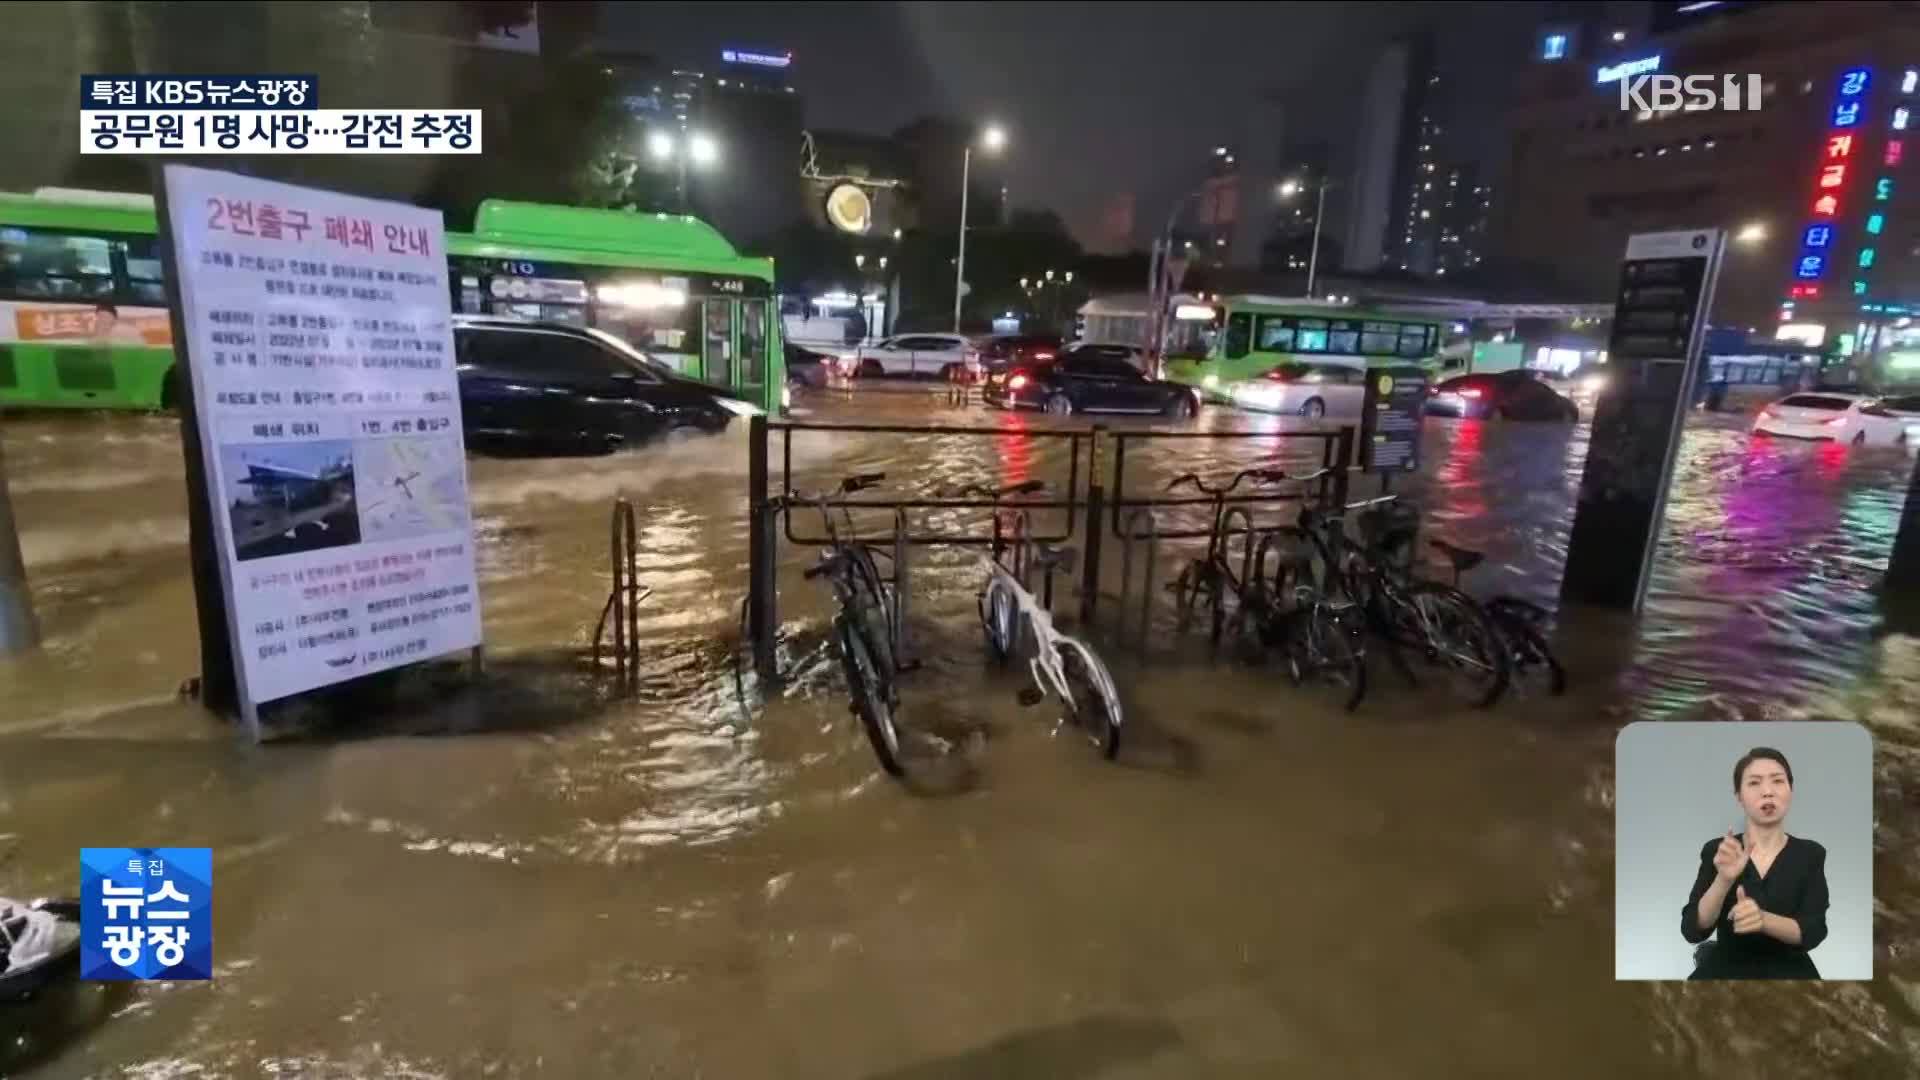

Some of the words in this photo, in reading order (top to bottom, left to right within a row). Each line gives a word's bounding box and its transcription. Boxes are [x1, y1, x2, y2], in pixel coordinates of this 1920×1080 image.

[207, 196, 312, 243] 2번출구
[323, 214, 375, 253] 폐쇄
[383, 223, 431, 257] 안내
